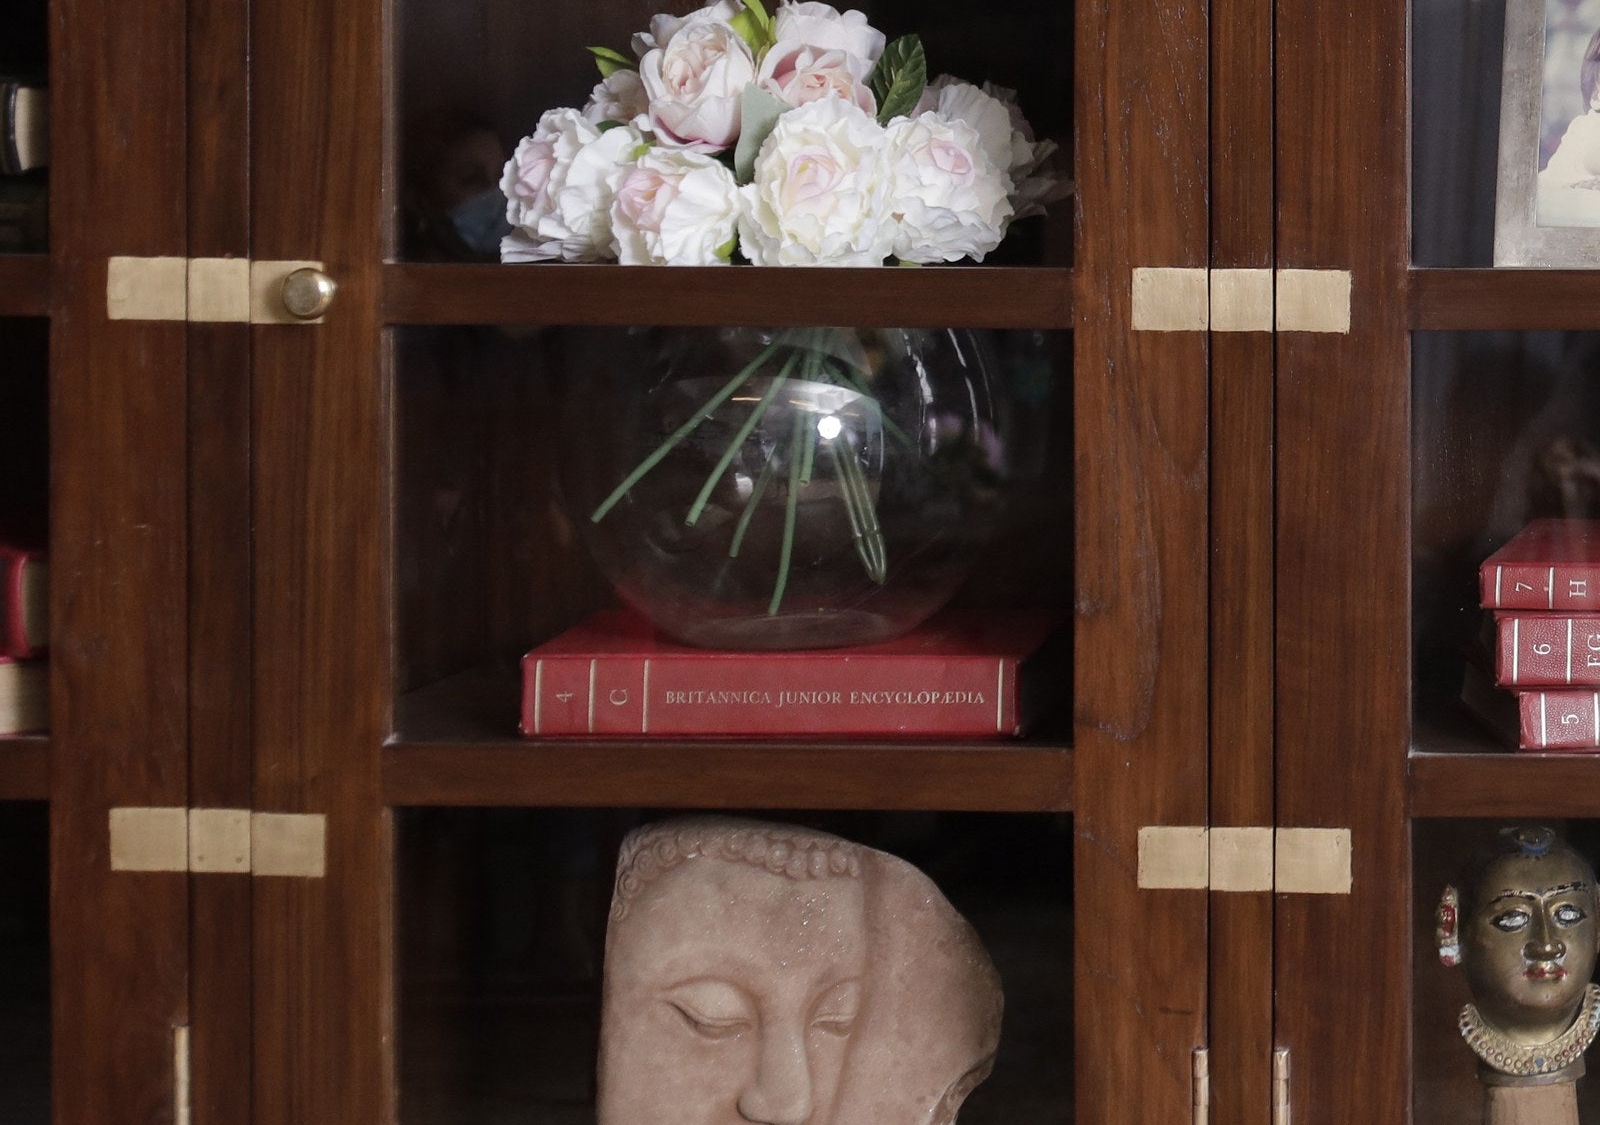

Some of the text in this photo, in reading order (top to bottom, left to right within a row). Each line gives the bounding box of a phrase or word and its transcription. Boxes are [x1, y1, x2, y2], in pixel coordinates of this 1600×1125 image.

[1515, 582, 1534, 593] 7
[1569, 579, 1587, 598] H
[1533, 643, 1552, 656] 6
[556, 691, 573, 703] 4
[665, 689, 772, 706] BRITANNICA
[775, 690, 842, 708] JUNIOR
[1561, 713, 1580, 725] 5
